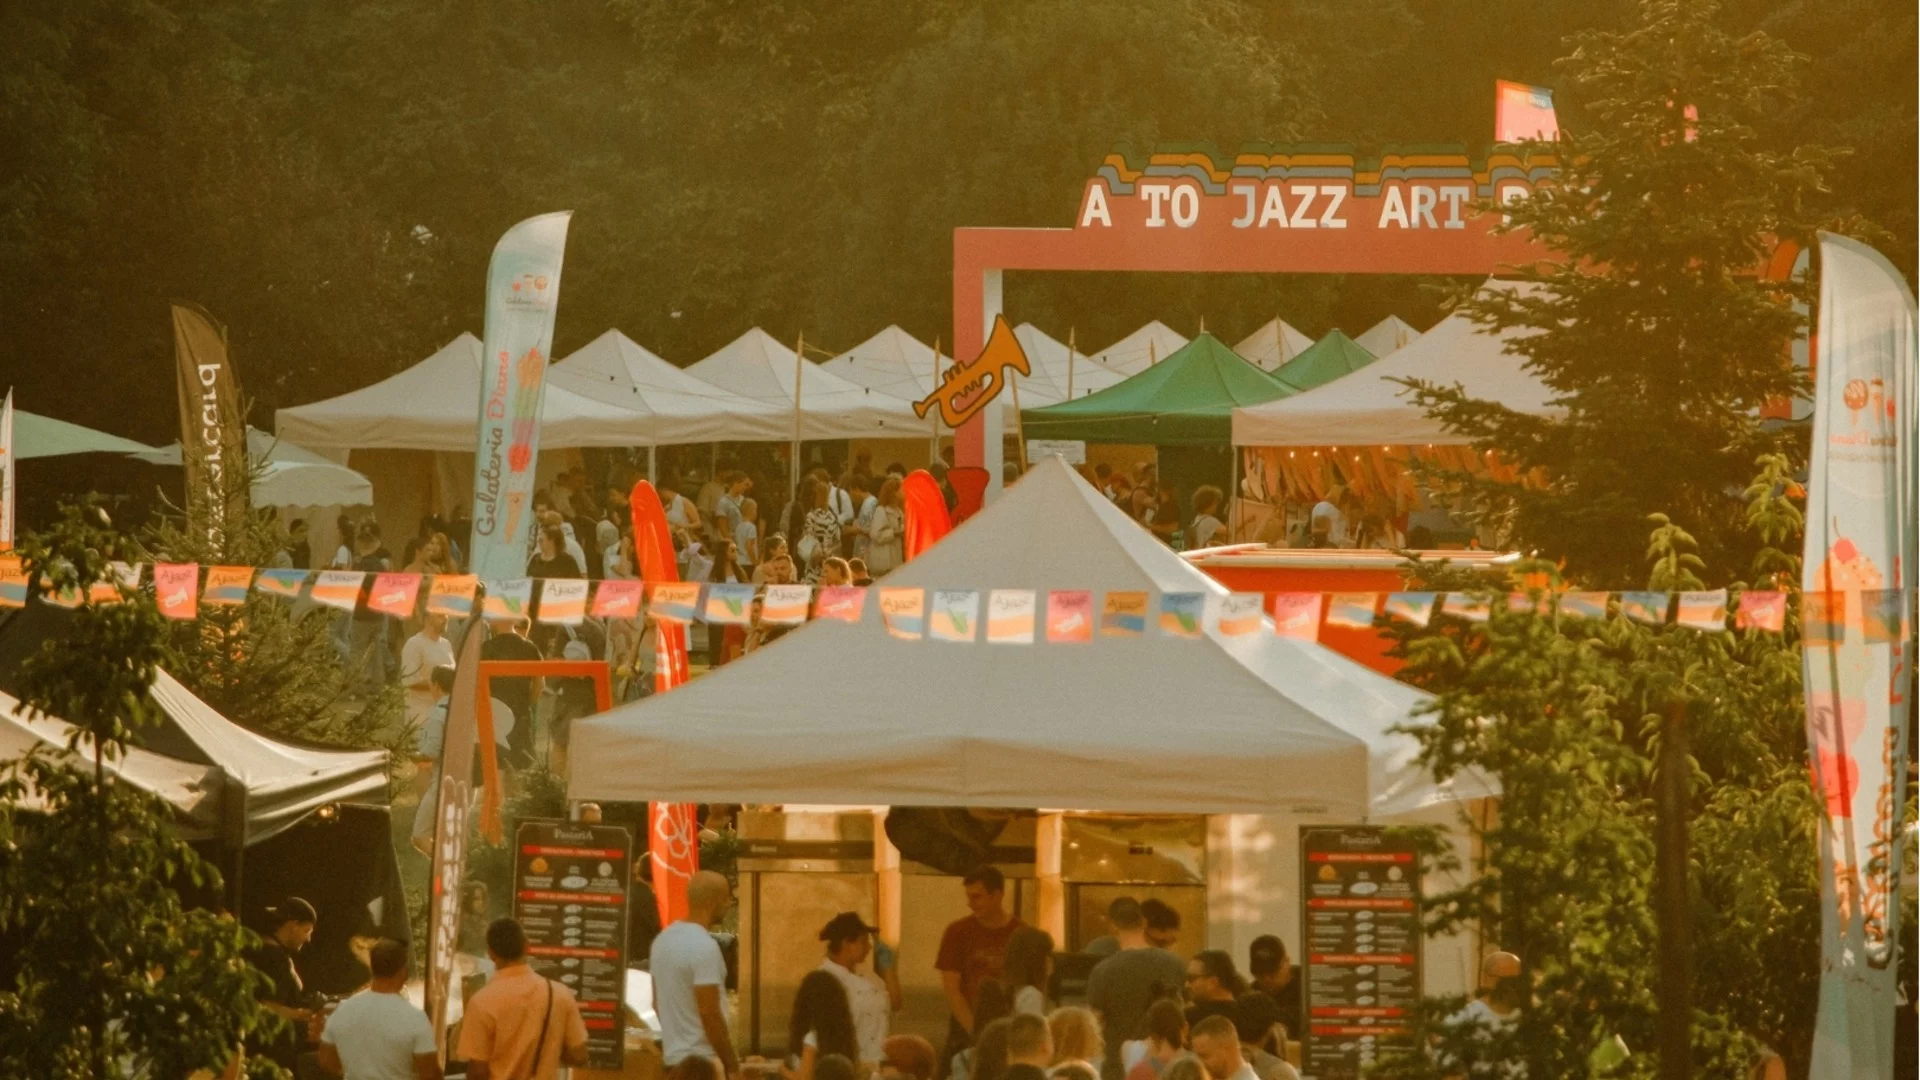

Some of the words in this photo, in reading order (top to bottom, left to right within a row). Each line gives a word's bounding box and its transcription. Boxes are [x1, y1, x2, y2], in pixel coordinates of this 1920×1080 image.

[1081, 184, 1112, 227] A
[1141, 184, 1200, 229] TO
[1231, 185, 1348, 229] JAZZ
[1378, 185, 1471, 230] ART
[476, 428, 504, 536] Gelateria
